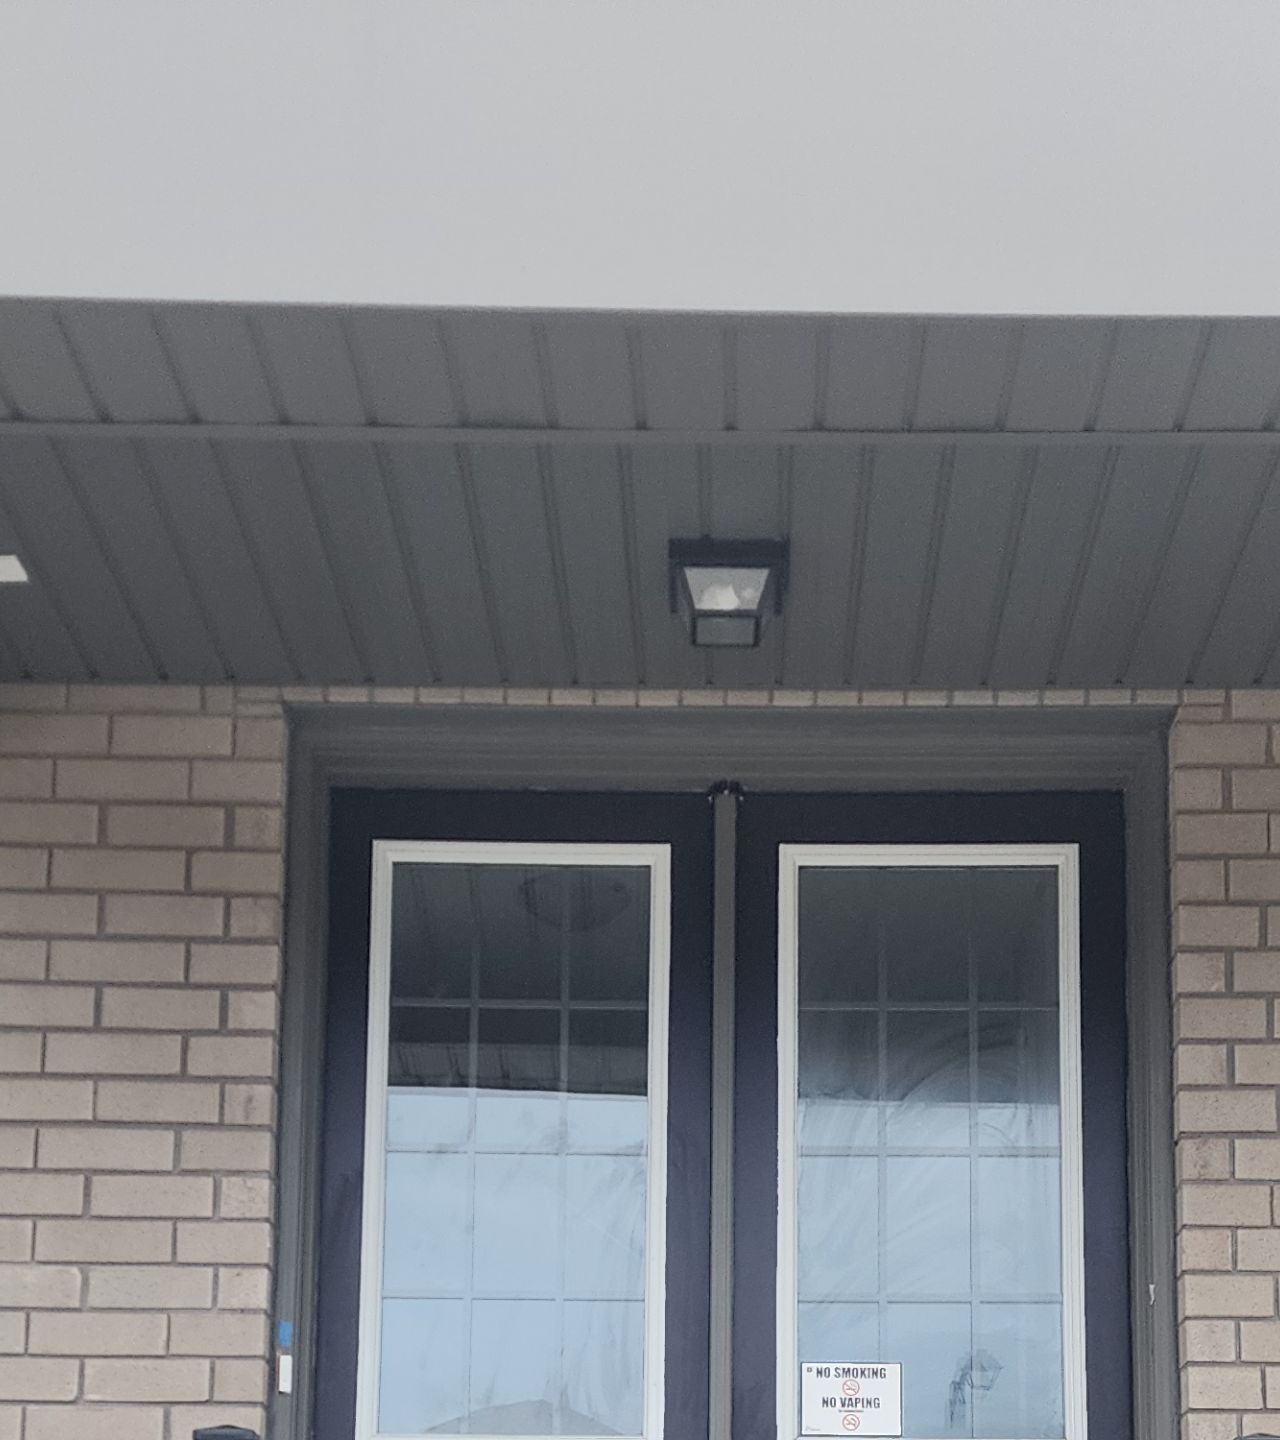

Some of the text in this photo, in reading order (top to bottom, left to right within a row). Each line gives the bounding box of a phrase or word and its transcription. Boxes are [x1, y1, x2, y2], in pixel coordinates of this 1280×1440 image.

[816, 1367, 887, 1379] NO SMOKING
[822, 1397, 880, 1409] NO VAPING
